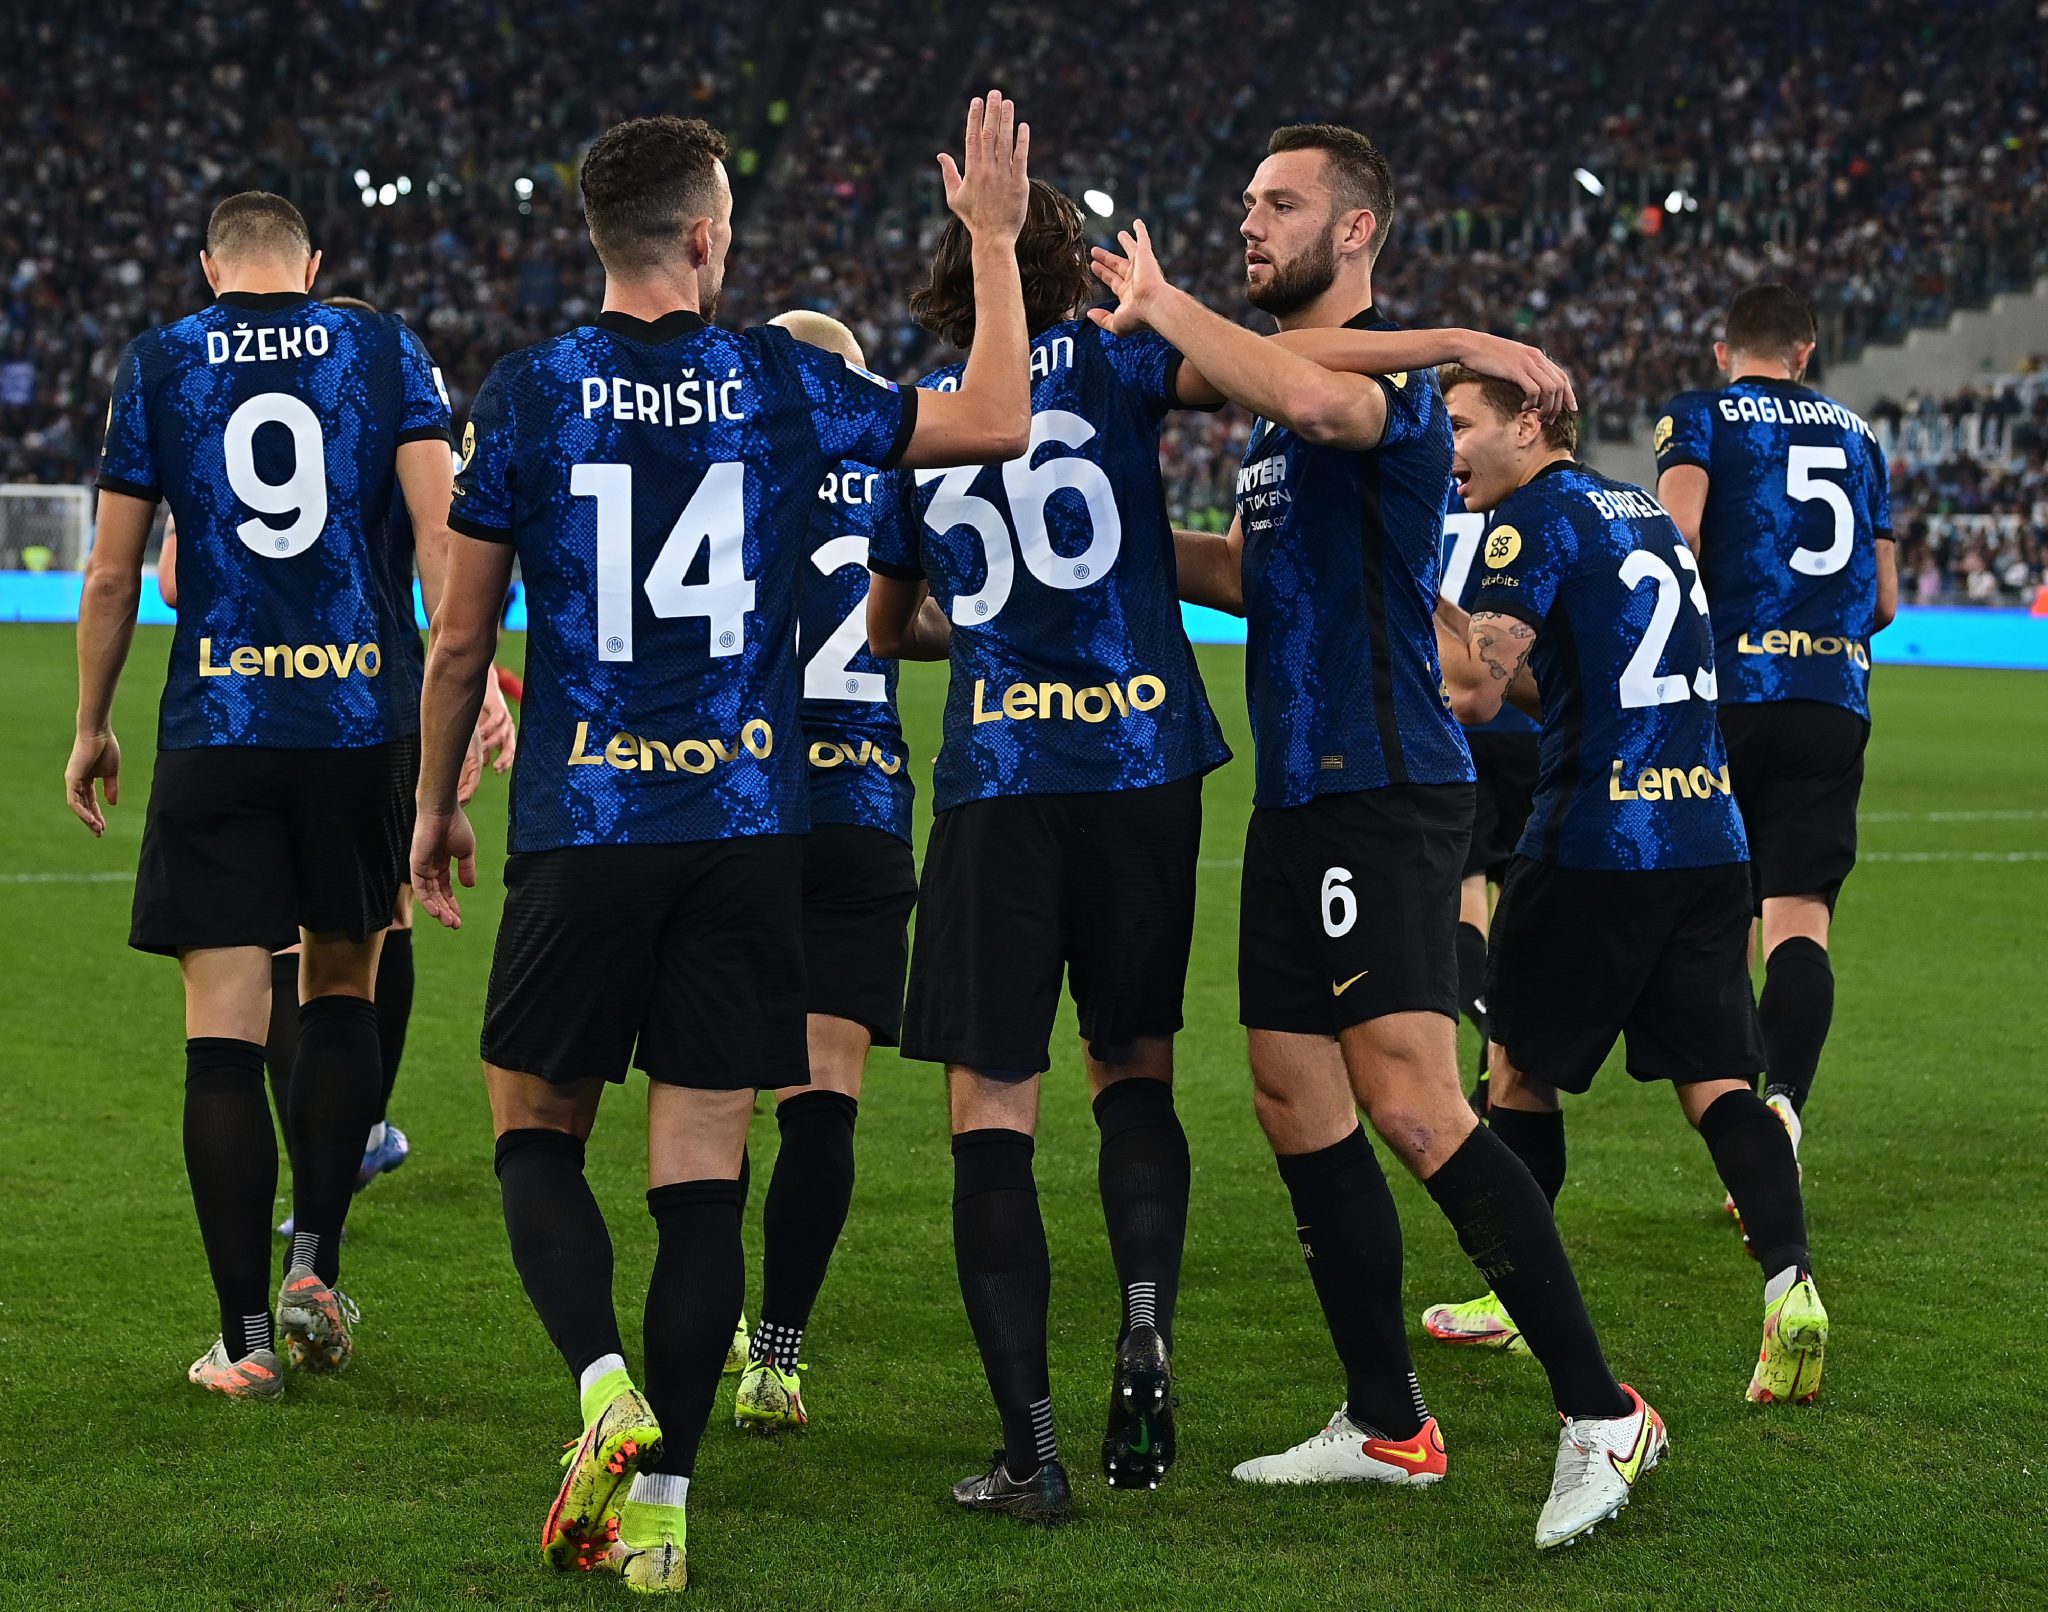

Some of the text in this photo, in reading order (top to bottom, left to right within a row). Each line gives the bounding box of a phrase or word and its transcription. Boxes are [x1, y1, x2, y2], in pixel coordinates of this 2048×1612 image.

[207, 323, 329, 364] DŽEKO
[583, 368, 744, 426] PERIŠIĆ
[223, 392, 328, 559] 9
[1236, 455, 1287, 495] INTER
[1246, 489, 1292, 511] TOKEN
[915, 410, 1122, 626] 36
[1586, 489, 1670, 520] BARELL
[1787, 445, 1855, 576] 5
[570, 461, 756, 662] 14
[1440, 512, 1486, 606] 7
[803, 535, 888, 703] 2
[199, 637, 381, 678] Lenovo
[1737, 629, 1870, 671] Lenovo
[972, 674, 1166, 725] Lenovo
[568, 720, 773, 774] Lenovo
[808, 740, 901, 775] ovo
[1609, 759, 1731, 801] Lenov
[1321, 866, 1358, 938] 6
